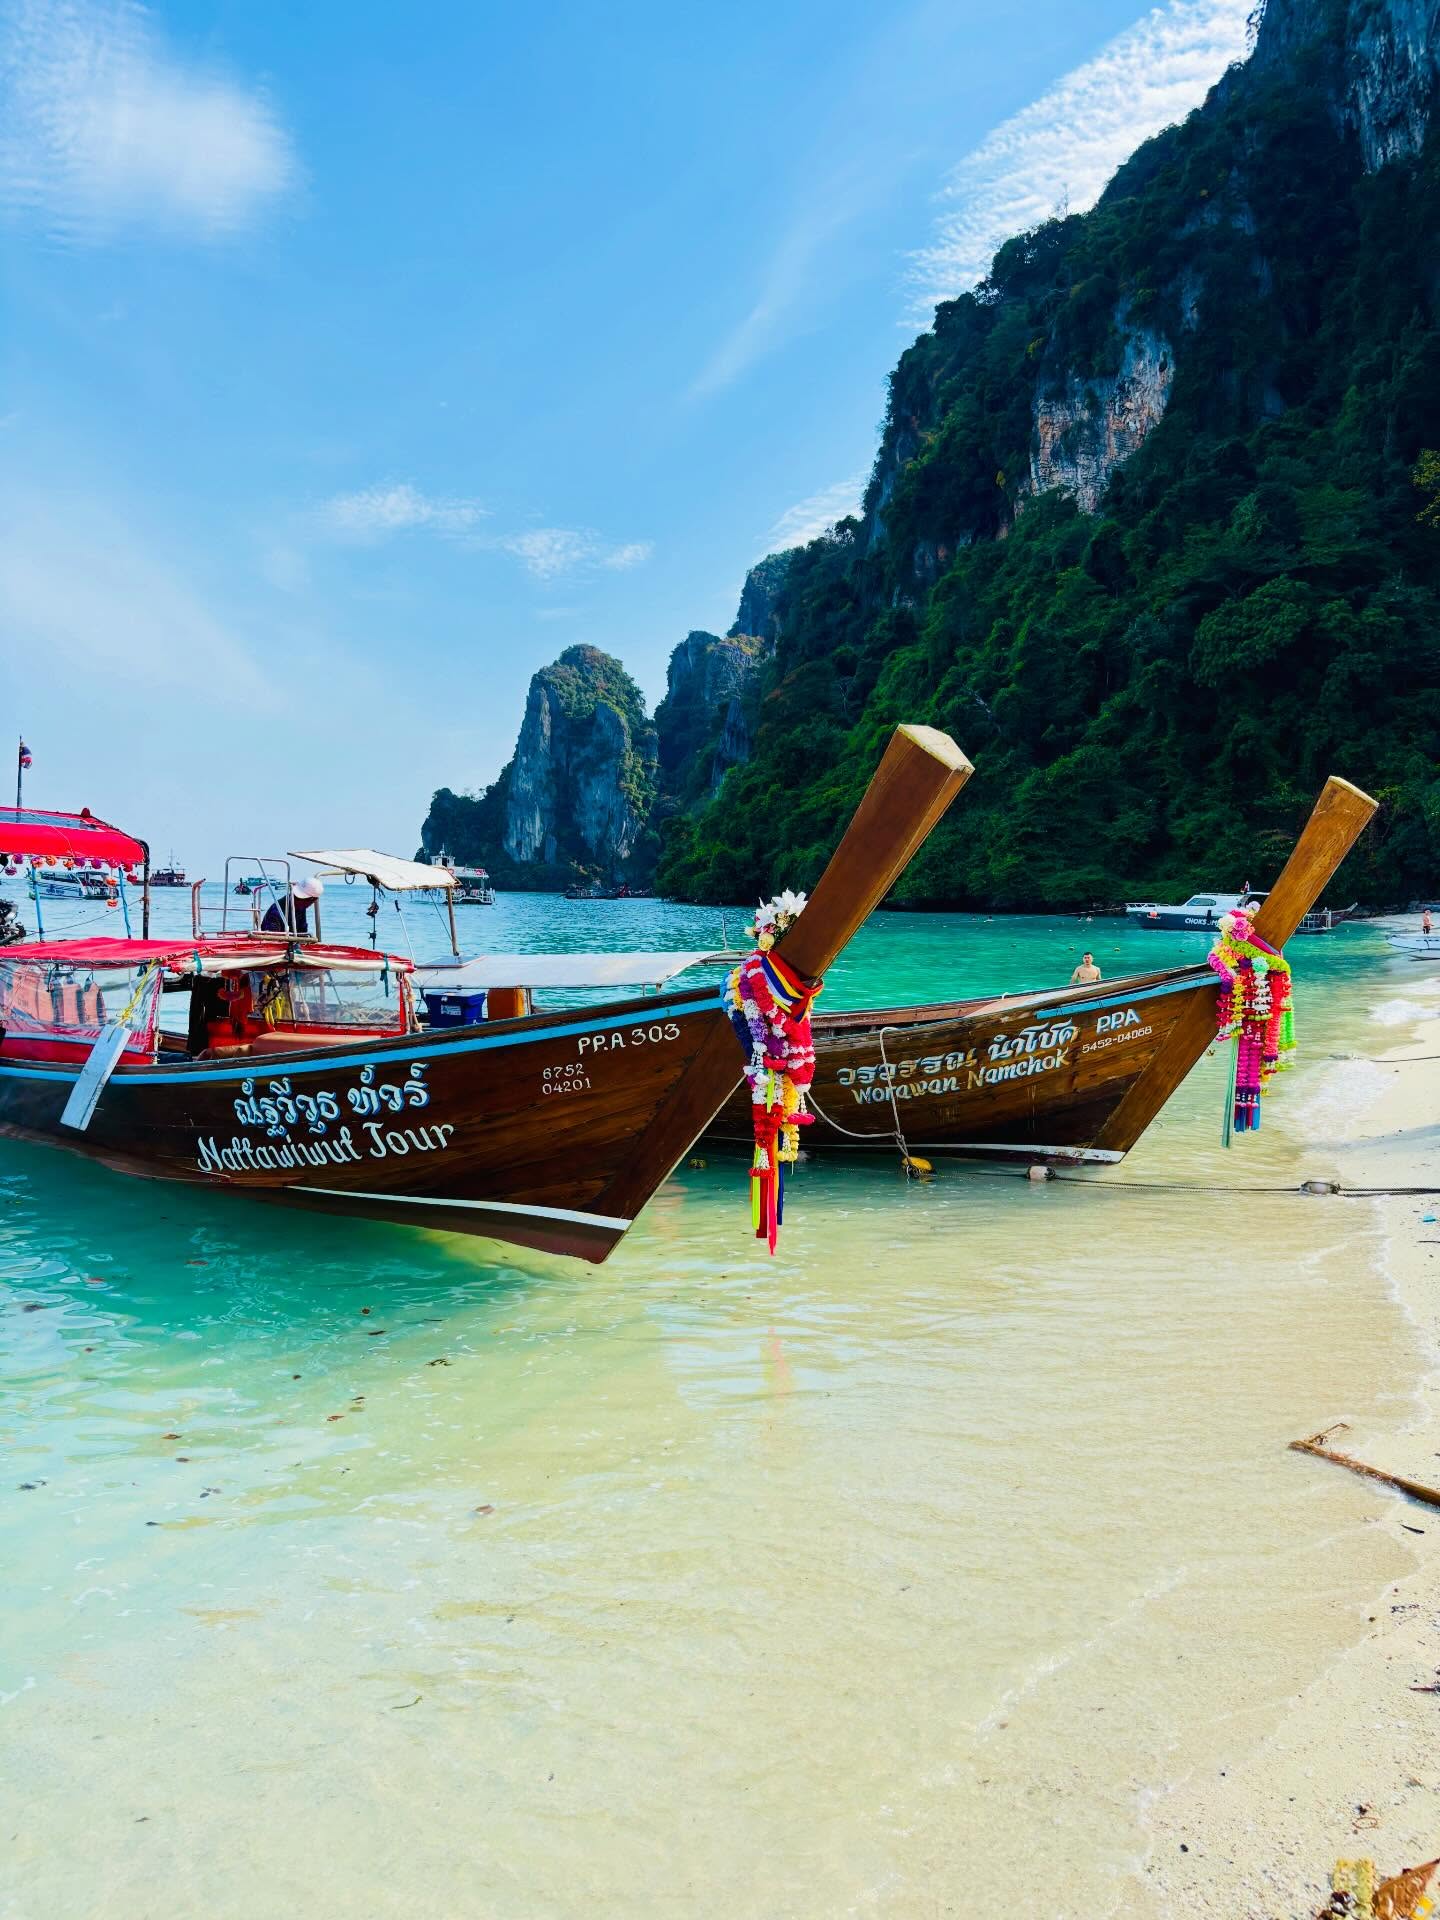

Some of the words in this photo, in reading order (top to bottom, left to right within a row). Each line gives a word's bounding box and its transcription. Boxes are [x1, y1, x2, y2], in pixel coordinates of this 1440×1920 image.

[631, 1023, 681, 1046] 303
[987, 1017, 1080, 1061] นำโชค
[542, 1063, 585, 1080] 6752
[542, 1077, 592, 1095] 04201
[347, 1062, 431, 1116] ทัวร์
[197, 1125, 363, 1173] Nattawiwut
[362, 1121, 455, 1159] Tour
